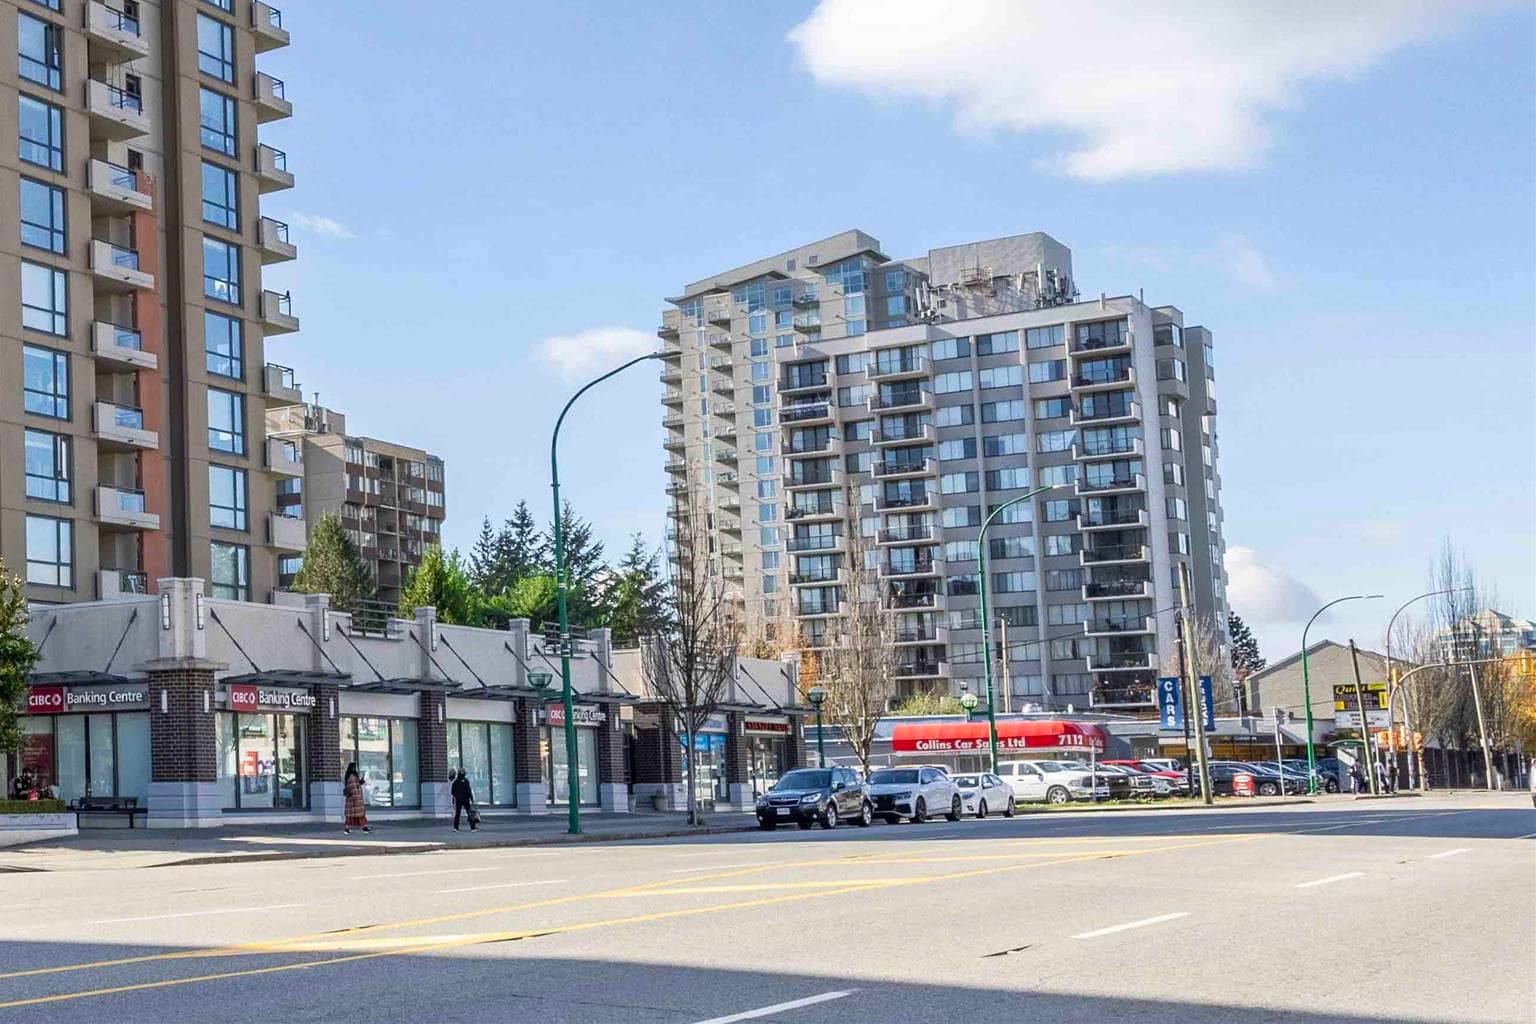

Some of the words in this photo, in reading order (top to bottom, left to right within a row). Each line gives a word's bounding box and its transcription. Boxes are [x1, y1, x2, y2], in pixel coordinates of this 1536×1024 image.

[29, 694, 52, 706] CIBC
[67, 691, 107, 705] Banking
[109, 690, 143, 703] Centre
[232, 691, 249, 704] CIBC
[259, 690, 290, 708] Banking
[291, 692, 316, 706] Centre
[1164, 681, 1176, 726] CARS
[916, 739, 952, 750] Collins
[955, 739, 973, 749] Car
[1007, 736, 1025, 747] Ltd
[1058, 734, 1083, 746] 7112
